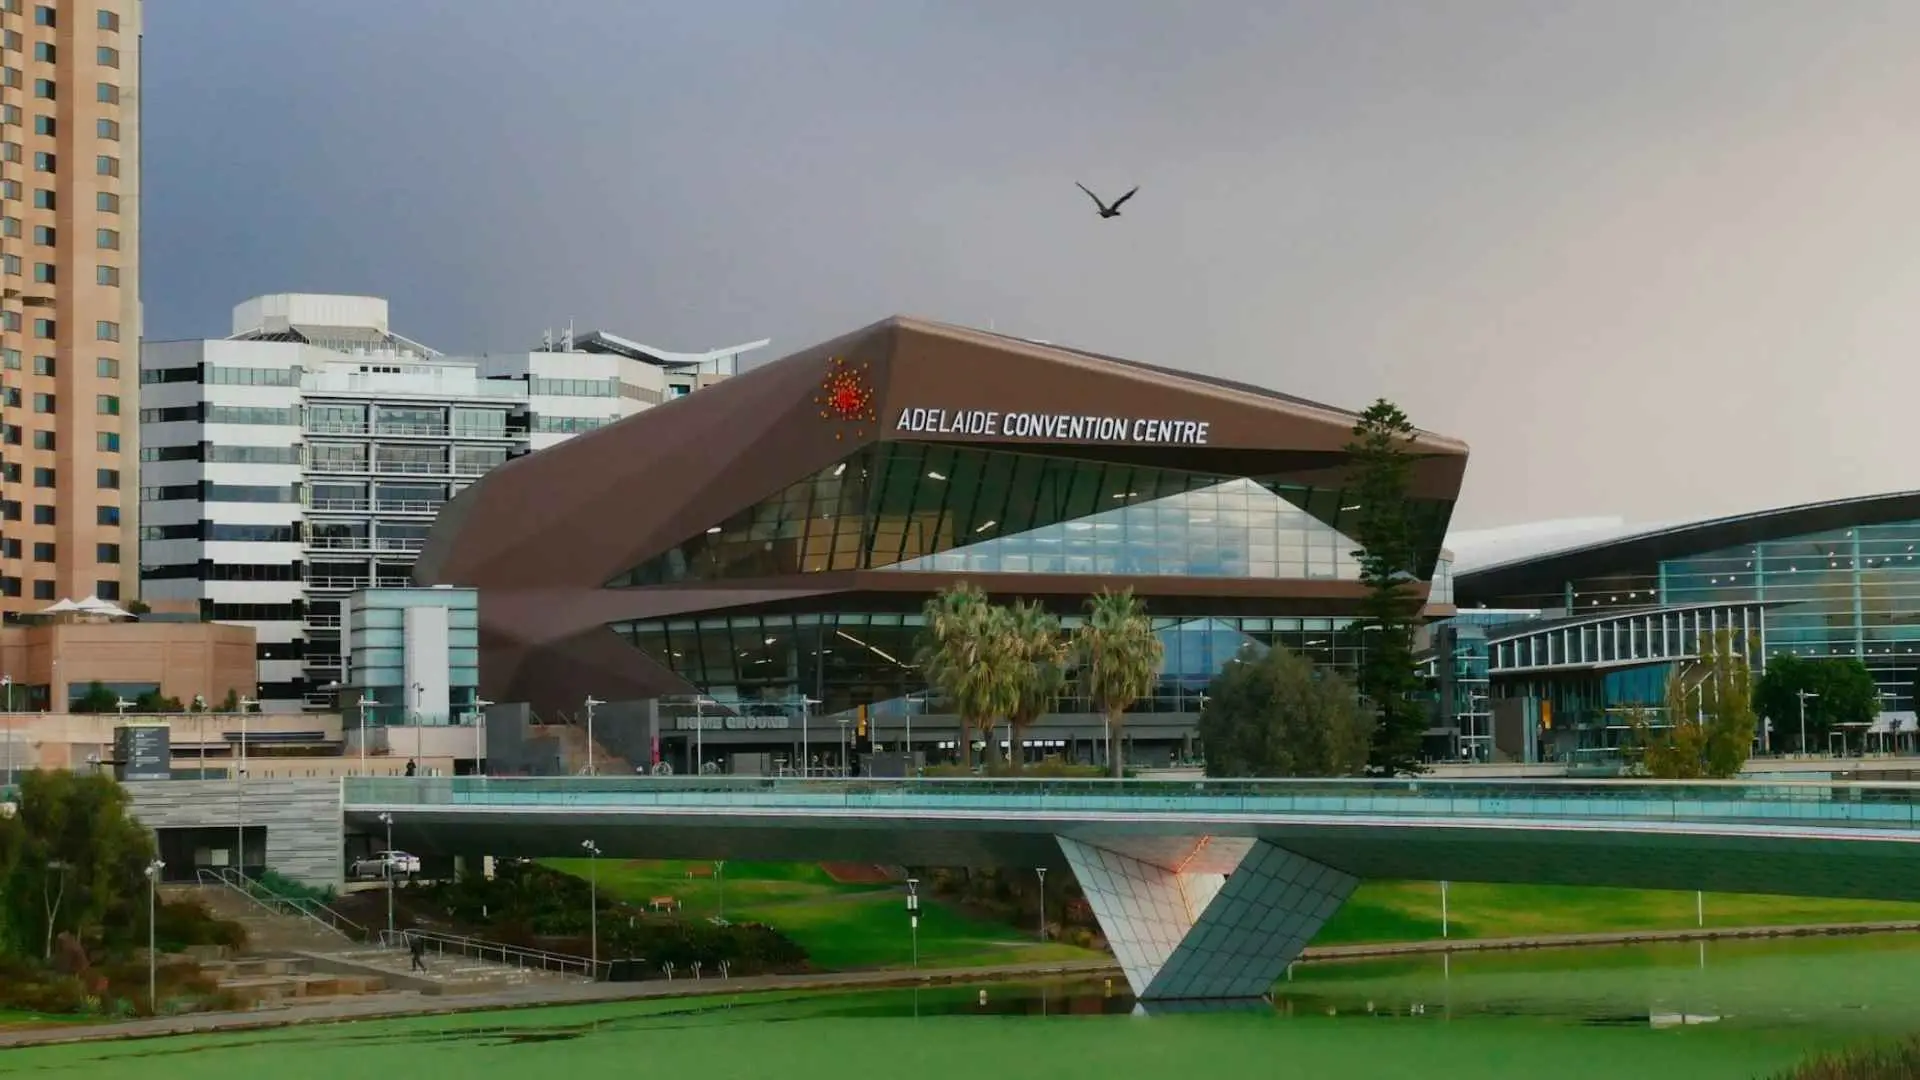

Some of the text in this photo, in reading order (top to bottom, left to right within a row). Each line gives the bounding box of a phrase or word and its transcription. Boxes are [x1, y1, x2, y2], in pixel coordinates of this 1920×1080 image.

[897, 408, 1210, 445] ADELAIDE CONVENTION CENTRE
